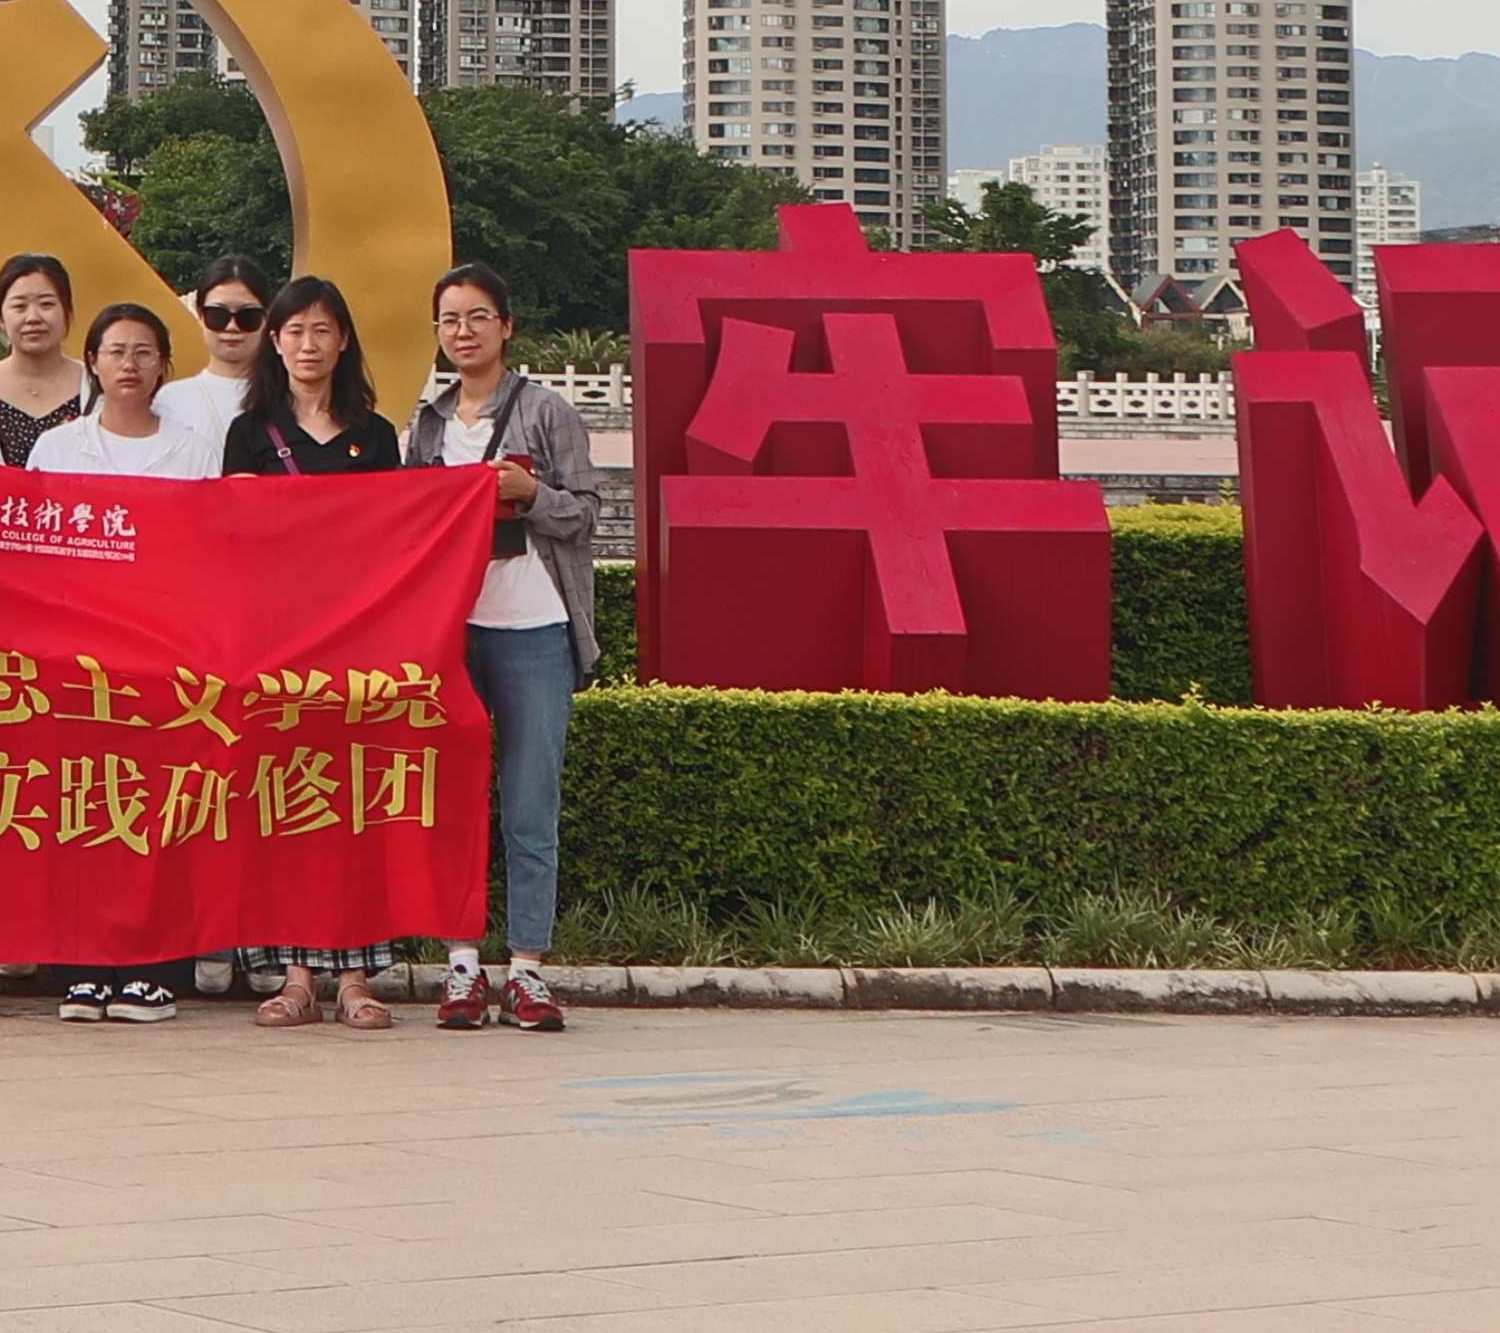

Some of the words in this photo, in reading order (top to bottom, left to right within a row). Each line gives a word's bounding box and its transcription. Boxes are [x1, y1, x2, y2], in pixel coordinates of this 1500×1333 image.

[1, 530, 46, 543] COLLEGE
[49, 534, 63, 544] OF
[66, 536, 136, 551] AGRICULTURE
